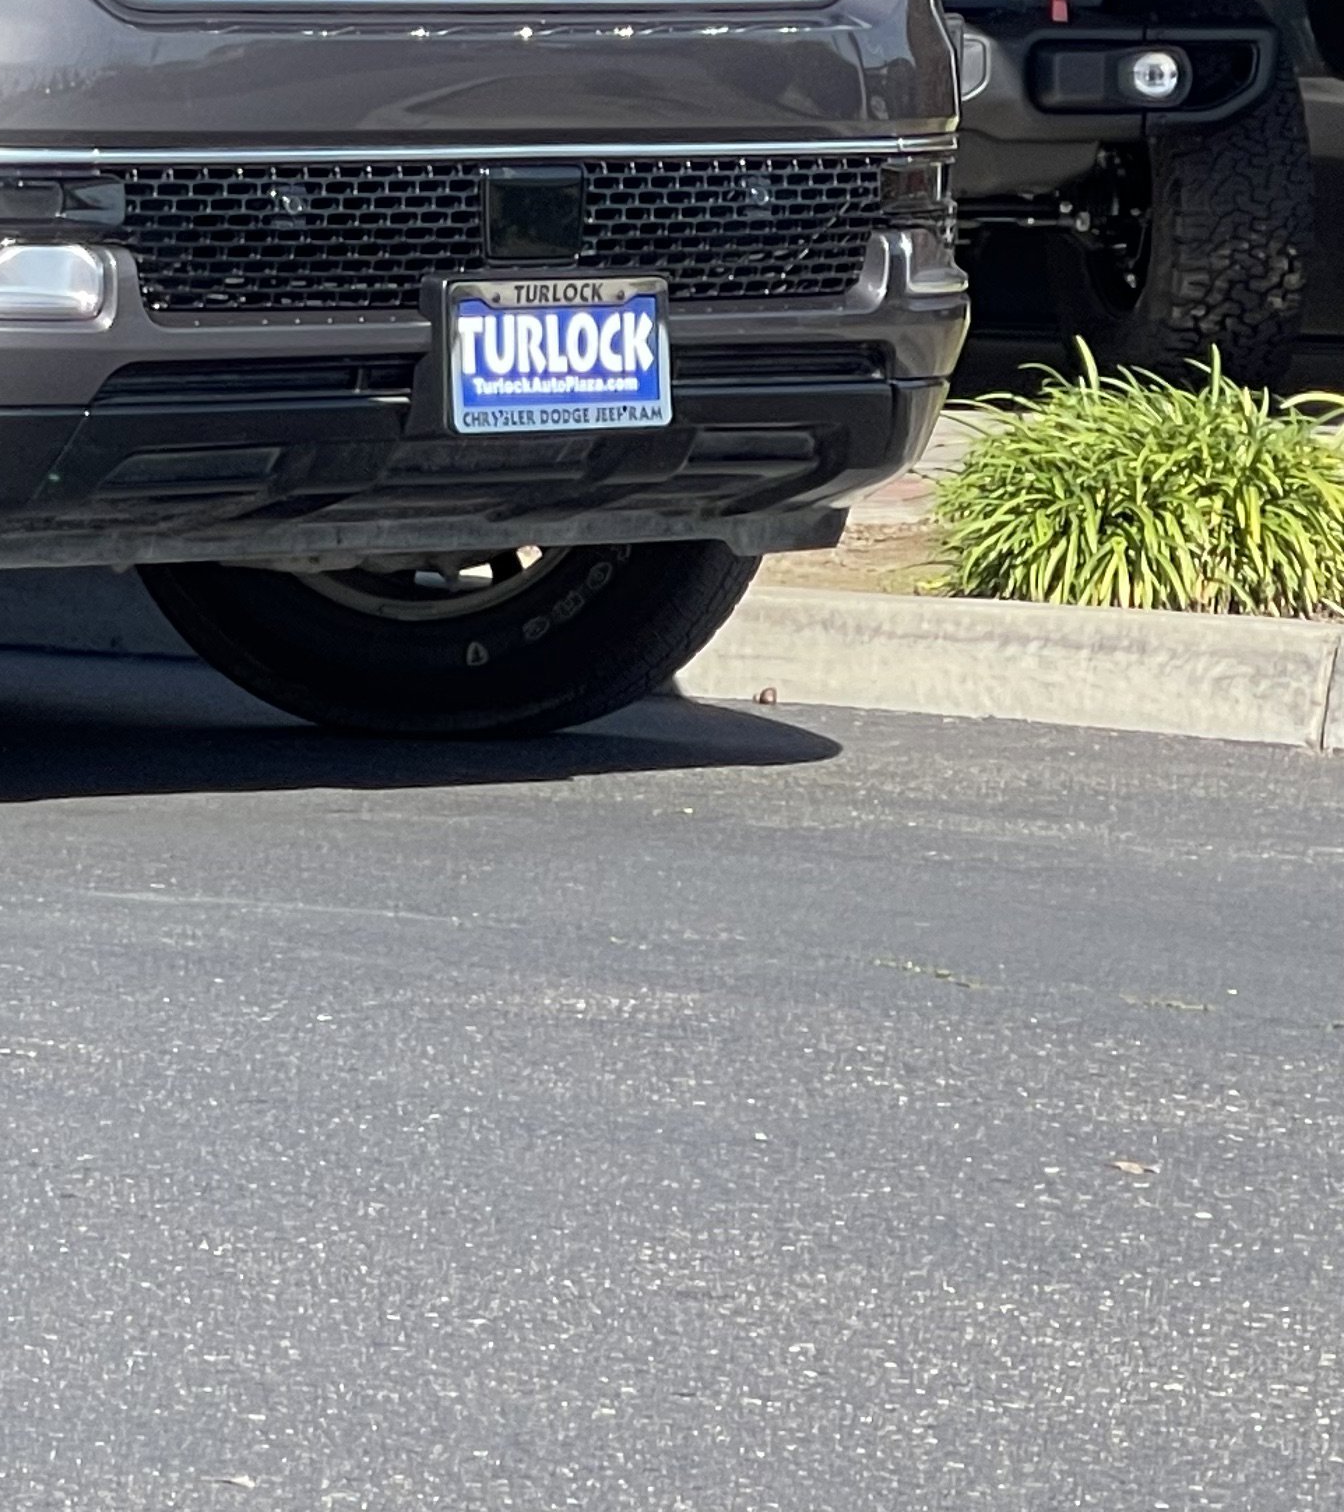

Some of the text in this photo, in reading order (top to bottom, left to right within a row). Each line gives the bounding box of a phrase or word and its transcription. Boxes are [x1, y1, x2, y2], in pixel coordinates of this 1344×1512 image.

[514, 282, 605, 304] TURLOCK
[458, 312, 655, 375] TURLOCK
[472, 376, 640, 396] TurlockAutoPlaza.com
[540, 407, 591, 425] DODGE
[628, 405, 664, 422] RAM
